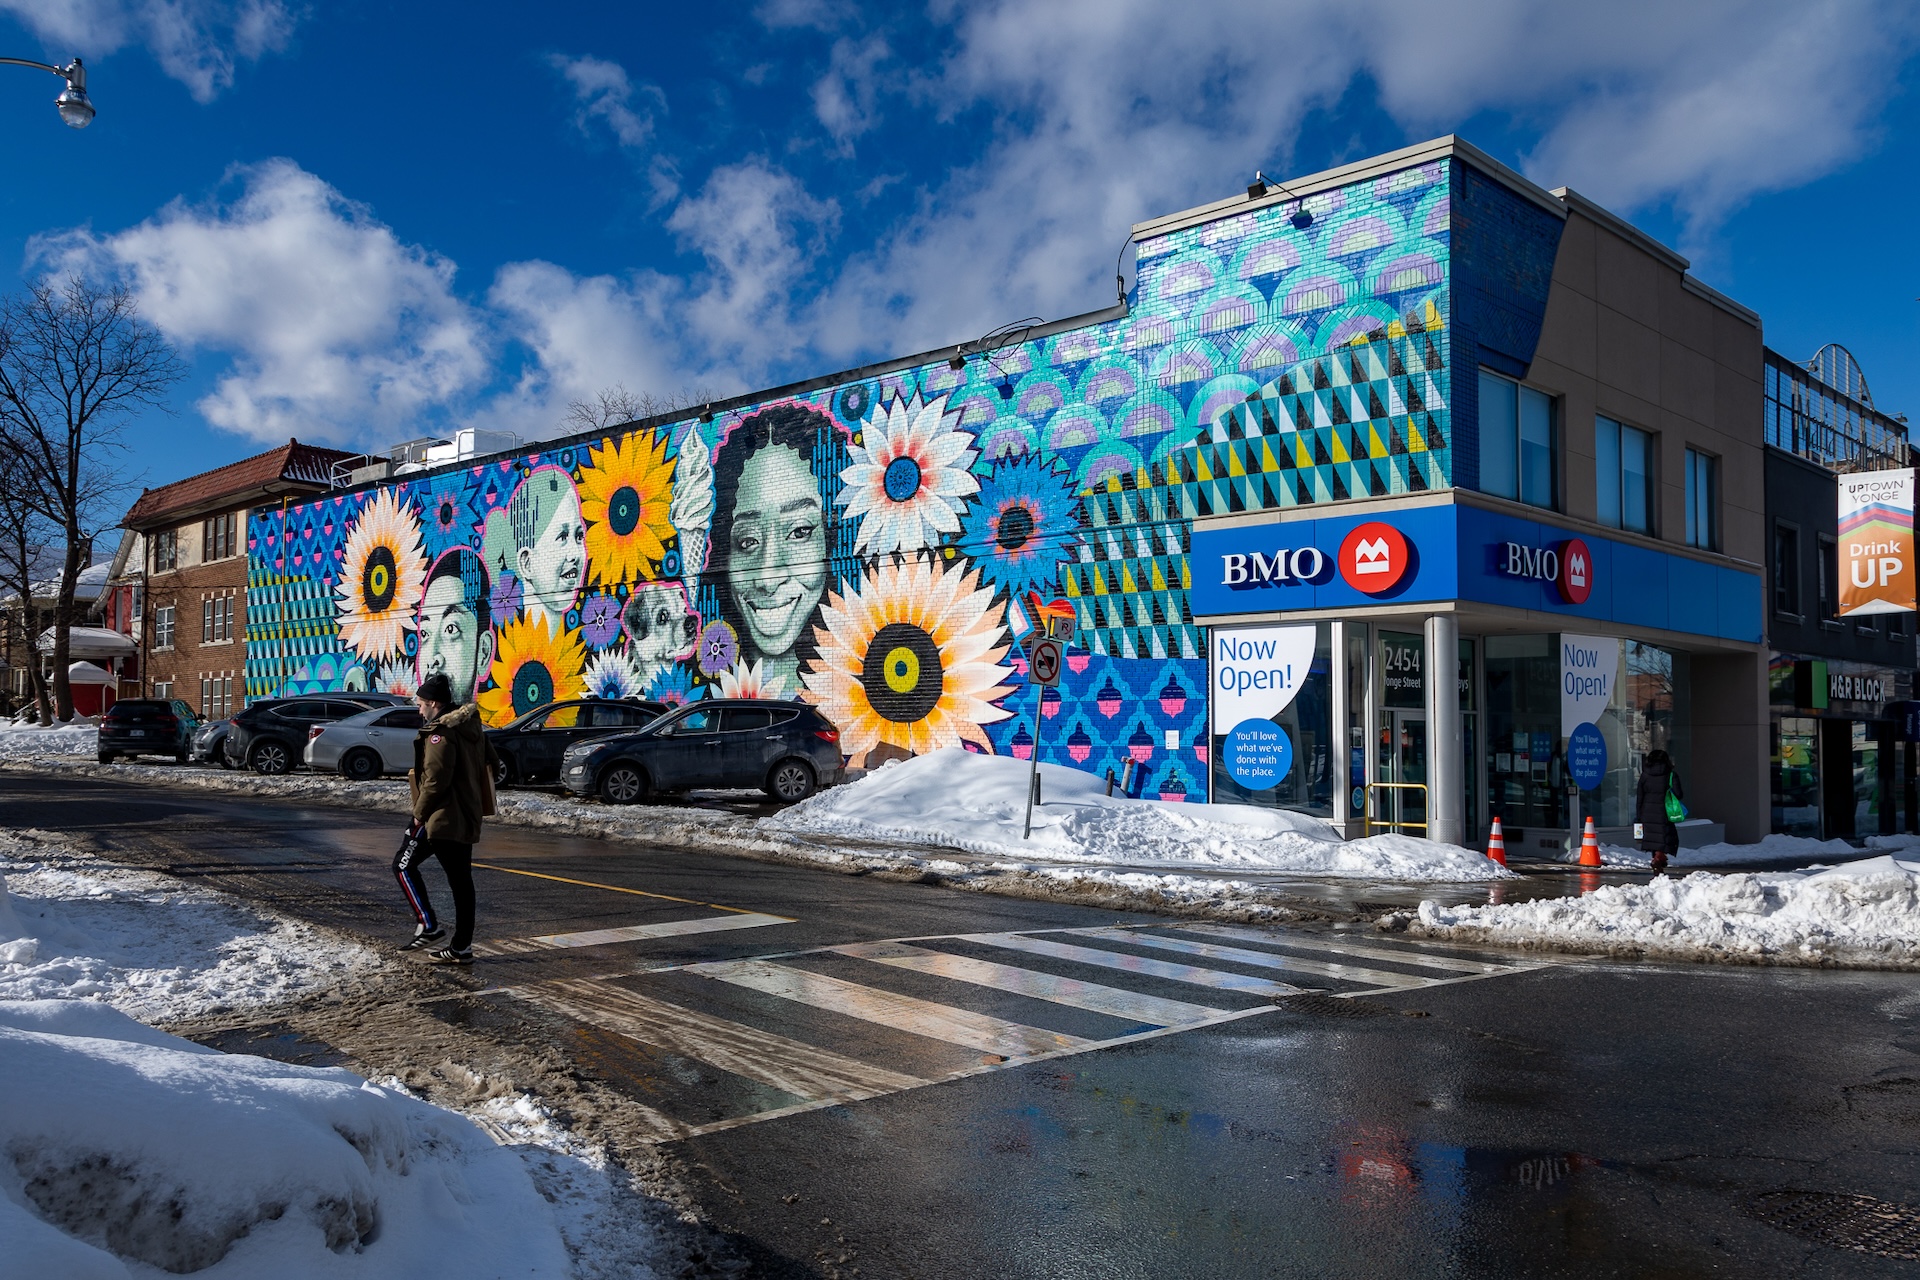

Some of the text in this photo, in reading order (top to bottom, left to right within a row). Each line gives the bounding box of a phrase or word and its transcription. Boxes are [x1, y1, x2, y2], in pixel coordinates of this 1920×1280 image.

[1848, 480, 1904, 493] UPTOWN
[1852, 491, 1899, 503] YONGE
[1850, 540, 1901, 557] Drink
[1221, 547, 1323, 585] BMO
[1507, 541, 1559, 581] BMO
[1851, 557, 1903, 588] UP
[1220, 637, 1277, 661] Now
[1565, 643, 1598, 668] Now
[1385, 646, 1420, 672] 2454
[1219, 664, 1292, 696] Open!
[1402, 676, 1421, 689] Street
[1458, 678, 1469, 692] ays
[1565, 671, 1606, 702] Open!
[1830, 674, 1886, 702] H&R BLOCK
[1259, 731, 1277, 741] love
[1588, 735, 1599, 744] love
[1236, 743, 1257, 752] what
[1575, 746, 1588, 755] what
[1236, 755, 1277, 765] done with
[1575, 757, 1600, 766] done with
[1236, 767, 1276, 778] the place.
[1575, 769, 1584, 777] the
